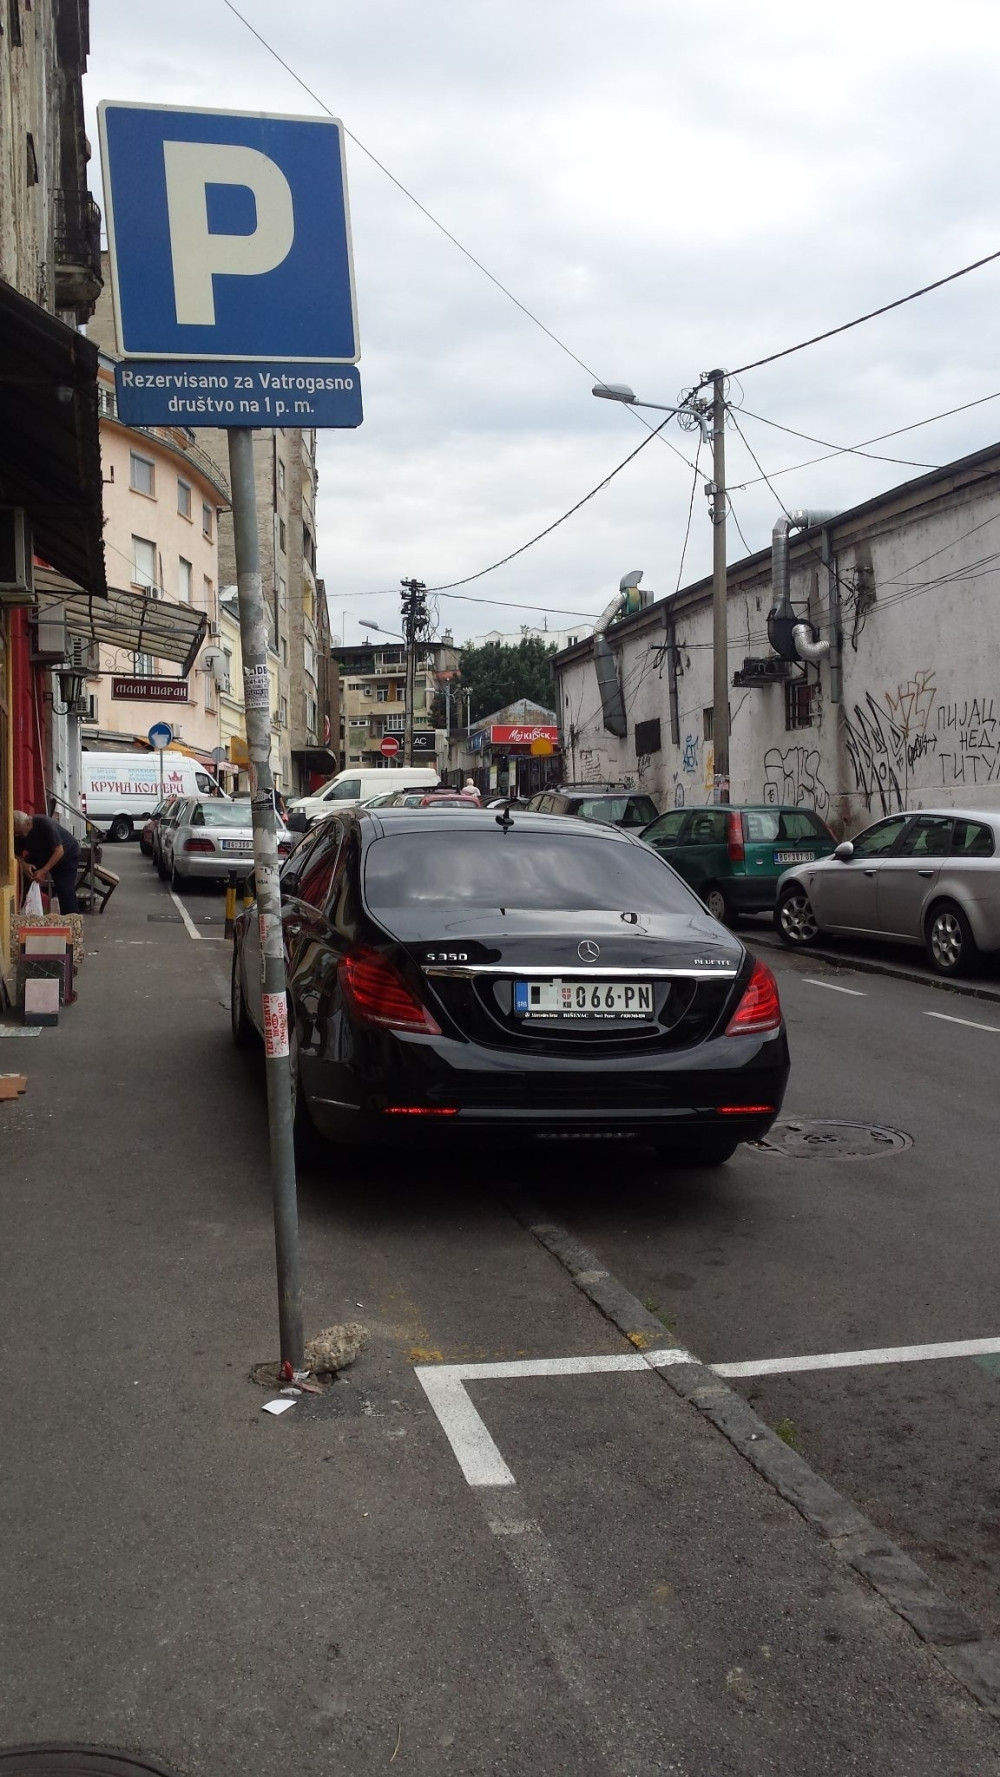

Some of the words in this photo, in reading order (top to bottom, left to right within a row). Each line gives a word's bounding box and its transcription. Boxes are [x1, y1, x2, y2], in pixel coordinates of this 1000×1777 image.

[163, 140, 295, 326] P
[121, 371, 229, 388] Rezervisano
[234, 377, 254, 389] za
[258, 373, 354, 394] Vatrogasno
[168, 396, 234, 412] društvo
[239, 401, 260, 413] na
[264, 397, 271, 412] 1
[276, 401, 290, 417] p.
[294, 401, 315, 413] m.
[150, 685, 187, 697] ШАРАН
[937, 698, 1000, 732] ПИЈАЦ
[938, 752, 1000, 784] ТИТУ
[91, 781, 131, 793] КРУНА
[438, 953, 468, 961] 350
[263, 994, 272, 1027] SERVIS
[265, 1029, 274, 1056] TEPIH
